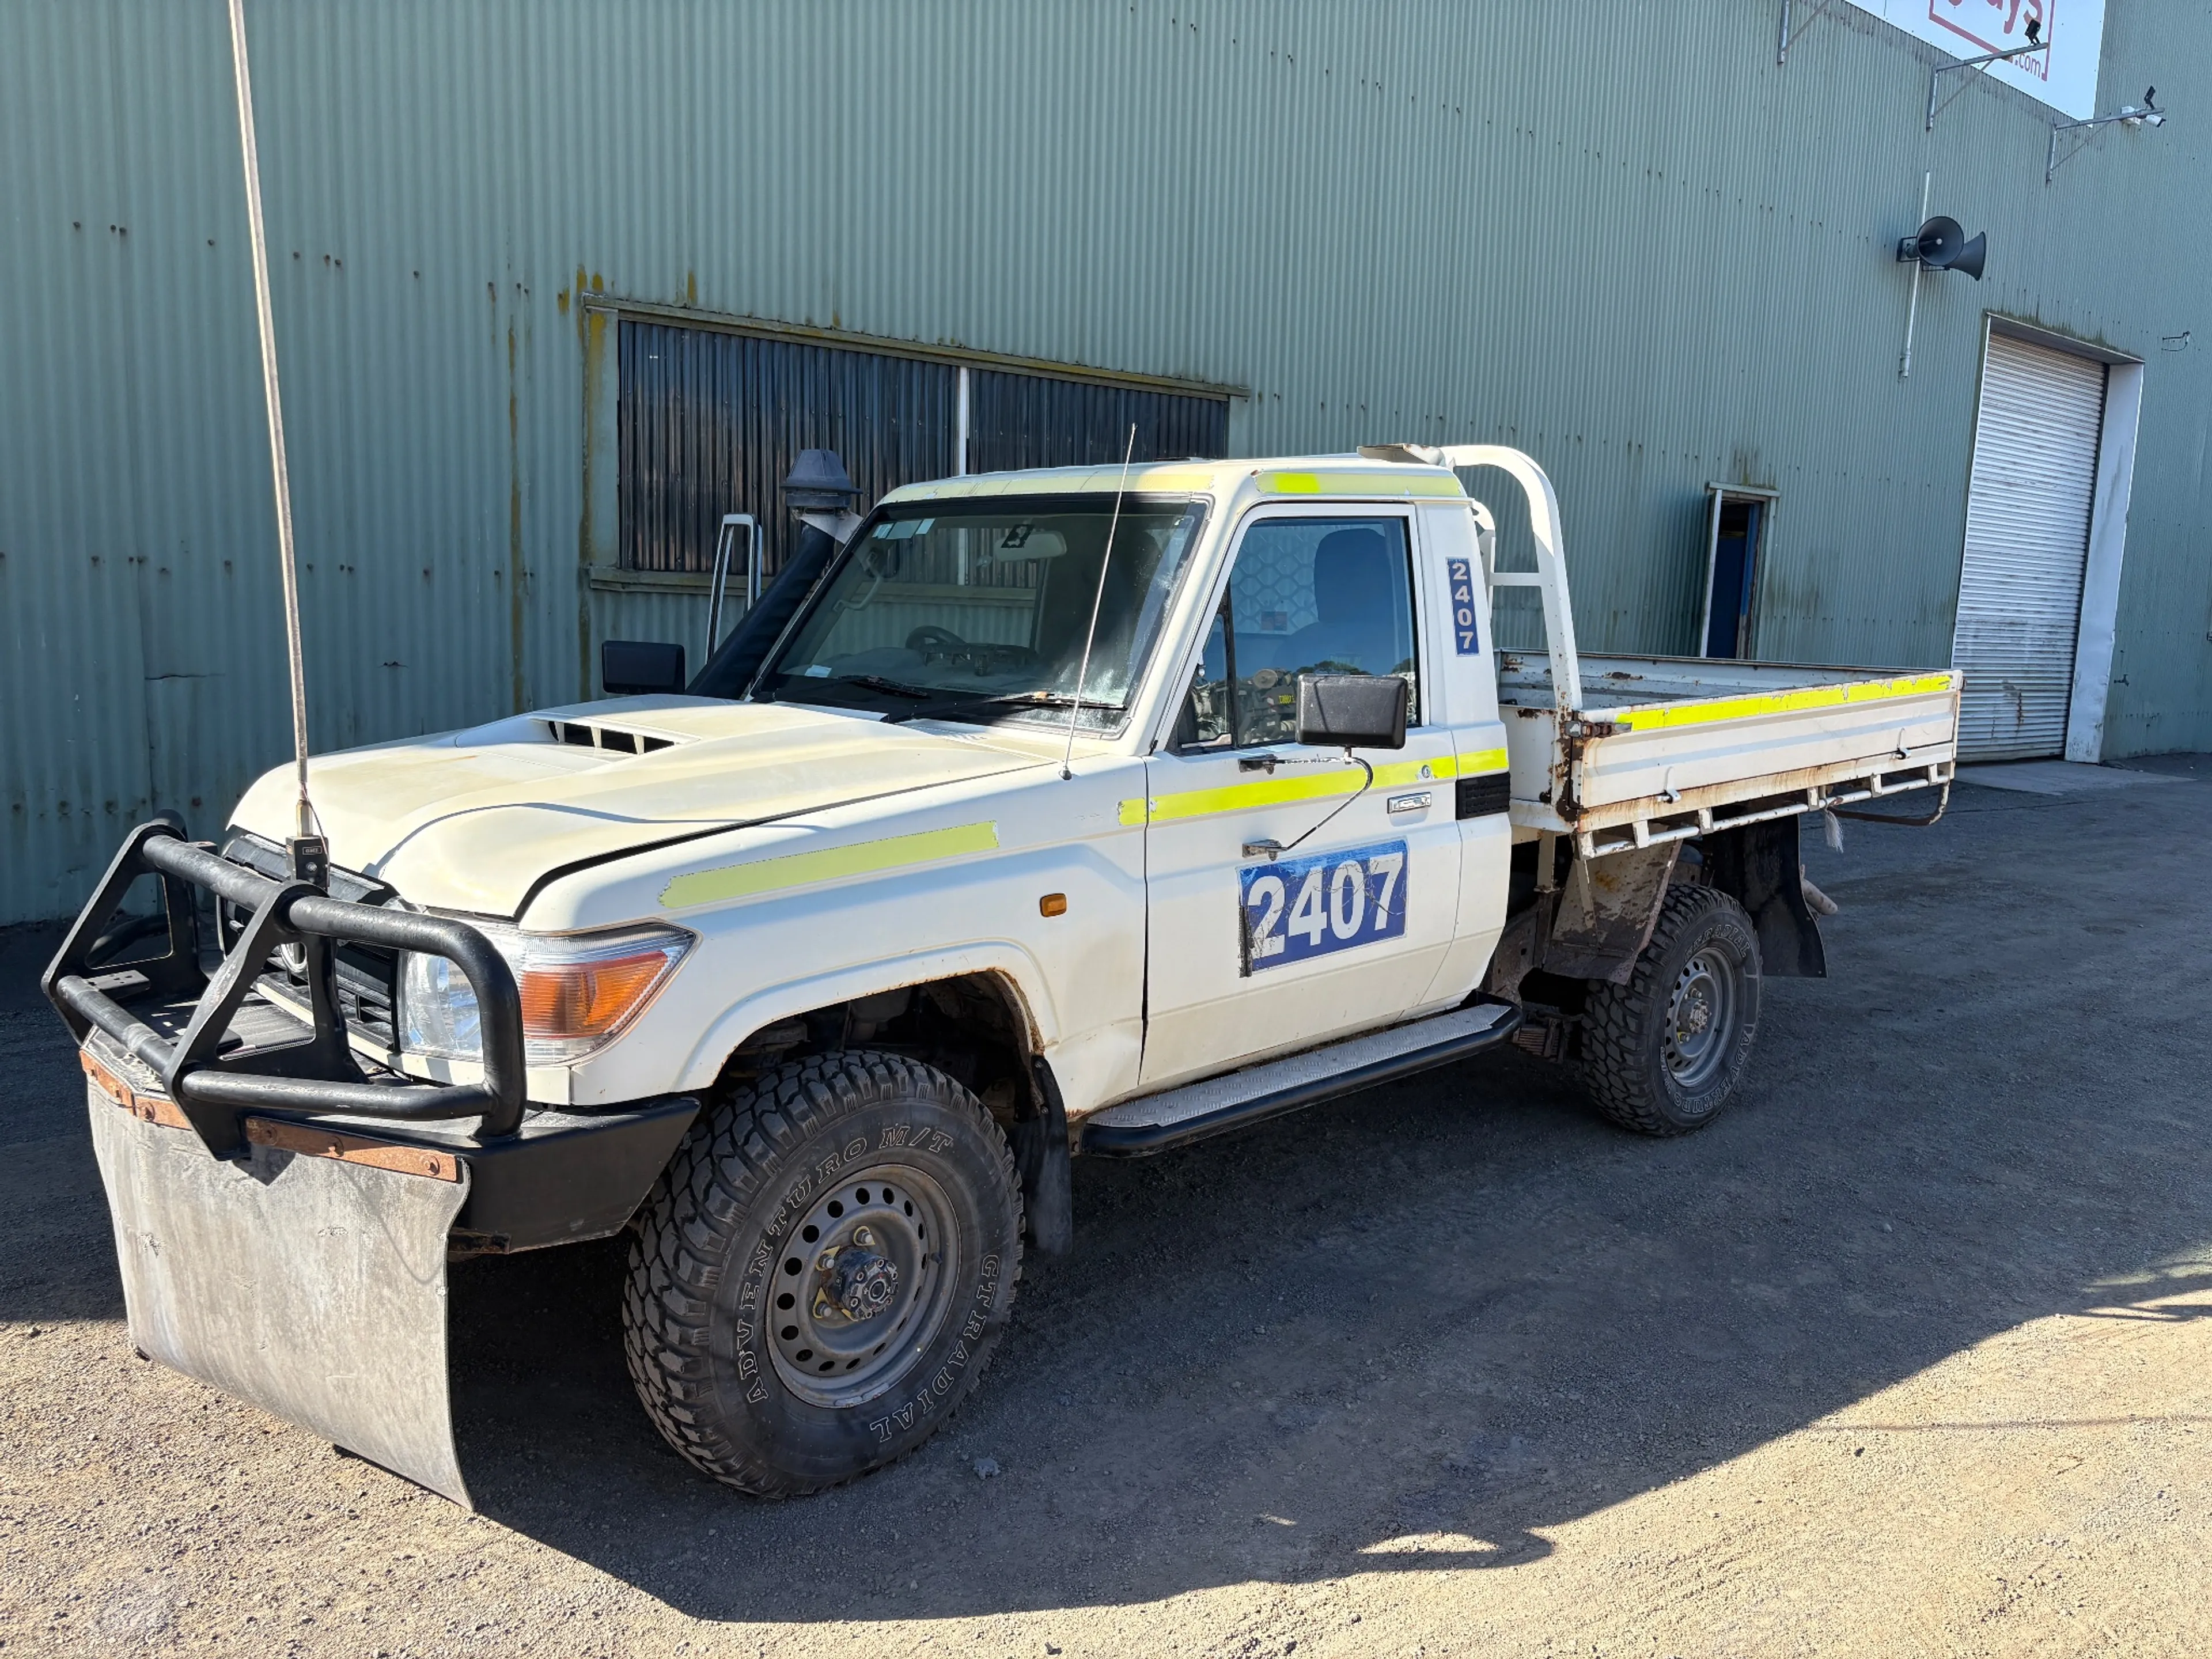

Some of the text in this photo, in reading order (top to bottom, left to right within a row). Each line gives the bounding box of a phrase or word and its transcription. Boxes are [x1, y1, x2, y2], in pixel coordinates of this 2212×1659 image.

[1452, 562, 1474, 649] 2407
[1248, 851, 1403, 960] 2407
[737, 1126, 953, 1403] ADVENTURO M/T
